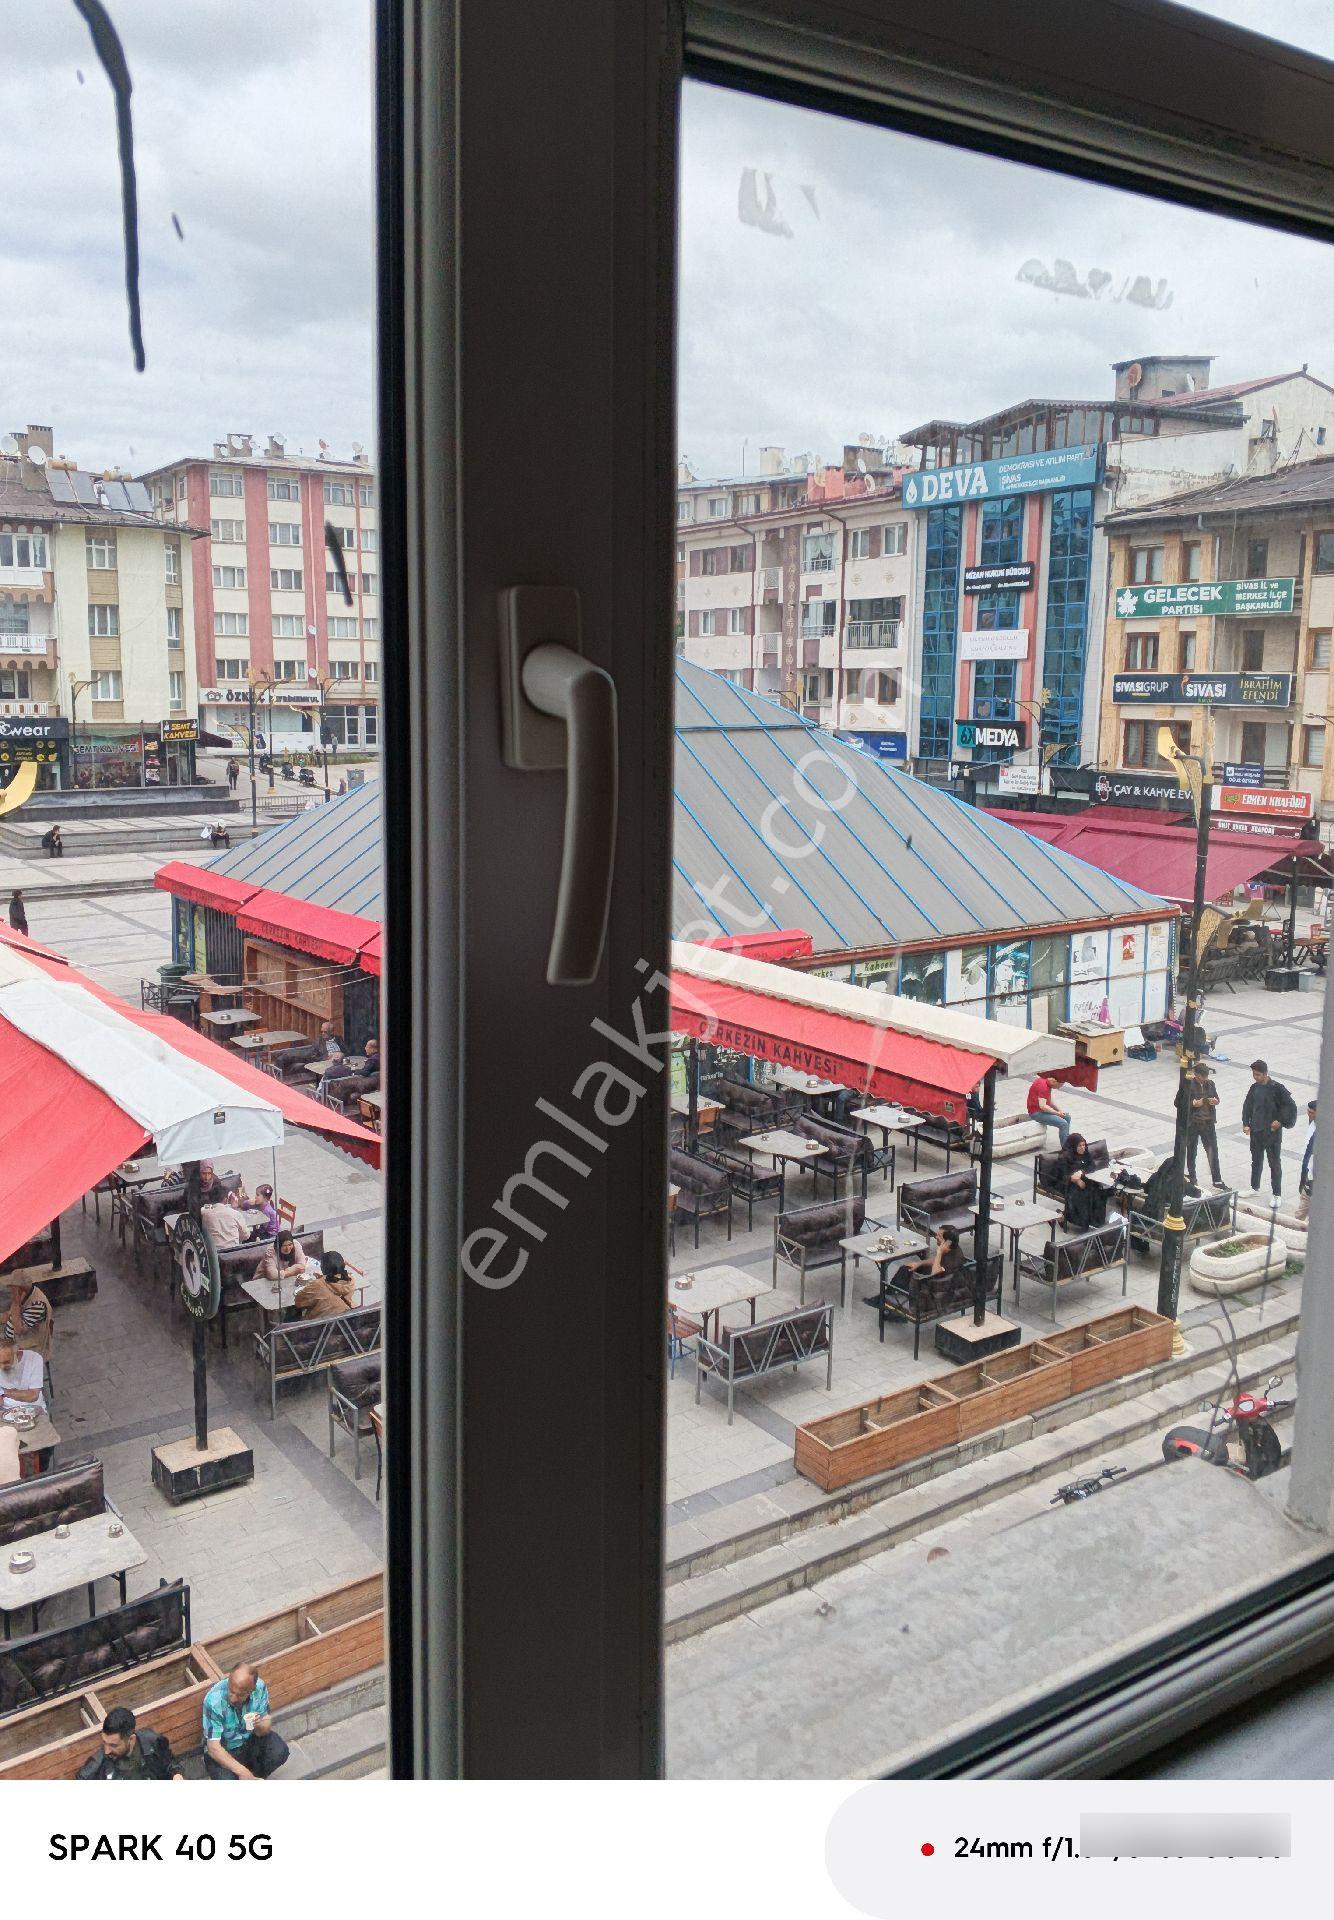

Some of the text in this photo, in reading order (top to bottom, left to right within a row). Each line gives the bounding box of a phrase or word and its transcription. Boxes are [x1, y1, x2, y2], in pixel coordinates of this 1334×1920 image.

[921, 466, 989, 503] DEVA
[1143, 585, 1223, 603] GELECEK
[1236, 581, 1259, 591] SİVAS
[1235, 589, 1288, 601] MERKEZ İLÇE
[171, 722, 191, 731] SEMT
[976, 727, 1020, 747] MEDYA
[1113, 784, 1132, 797] ÇAY
[1133, 786, 1141, 796] &
[1143, 786, 1177, 799] KAHVE
[773, 1043, 838, 1076] KAHVESİ
